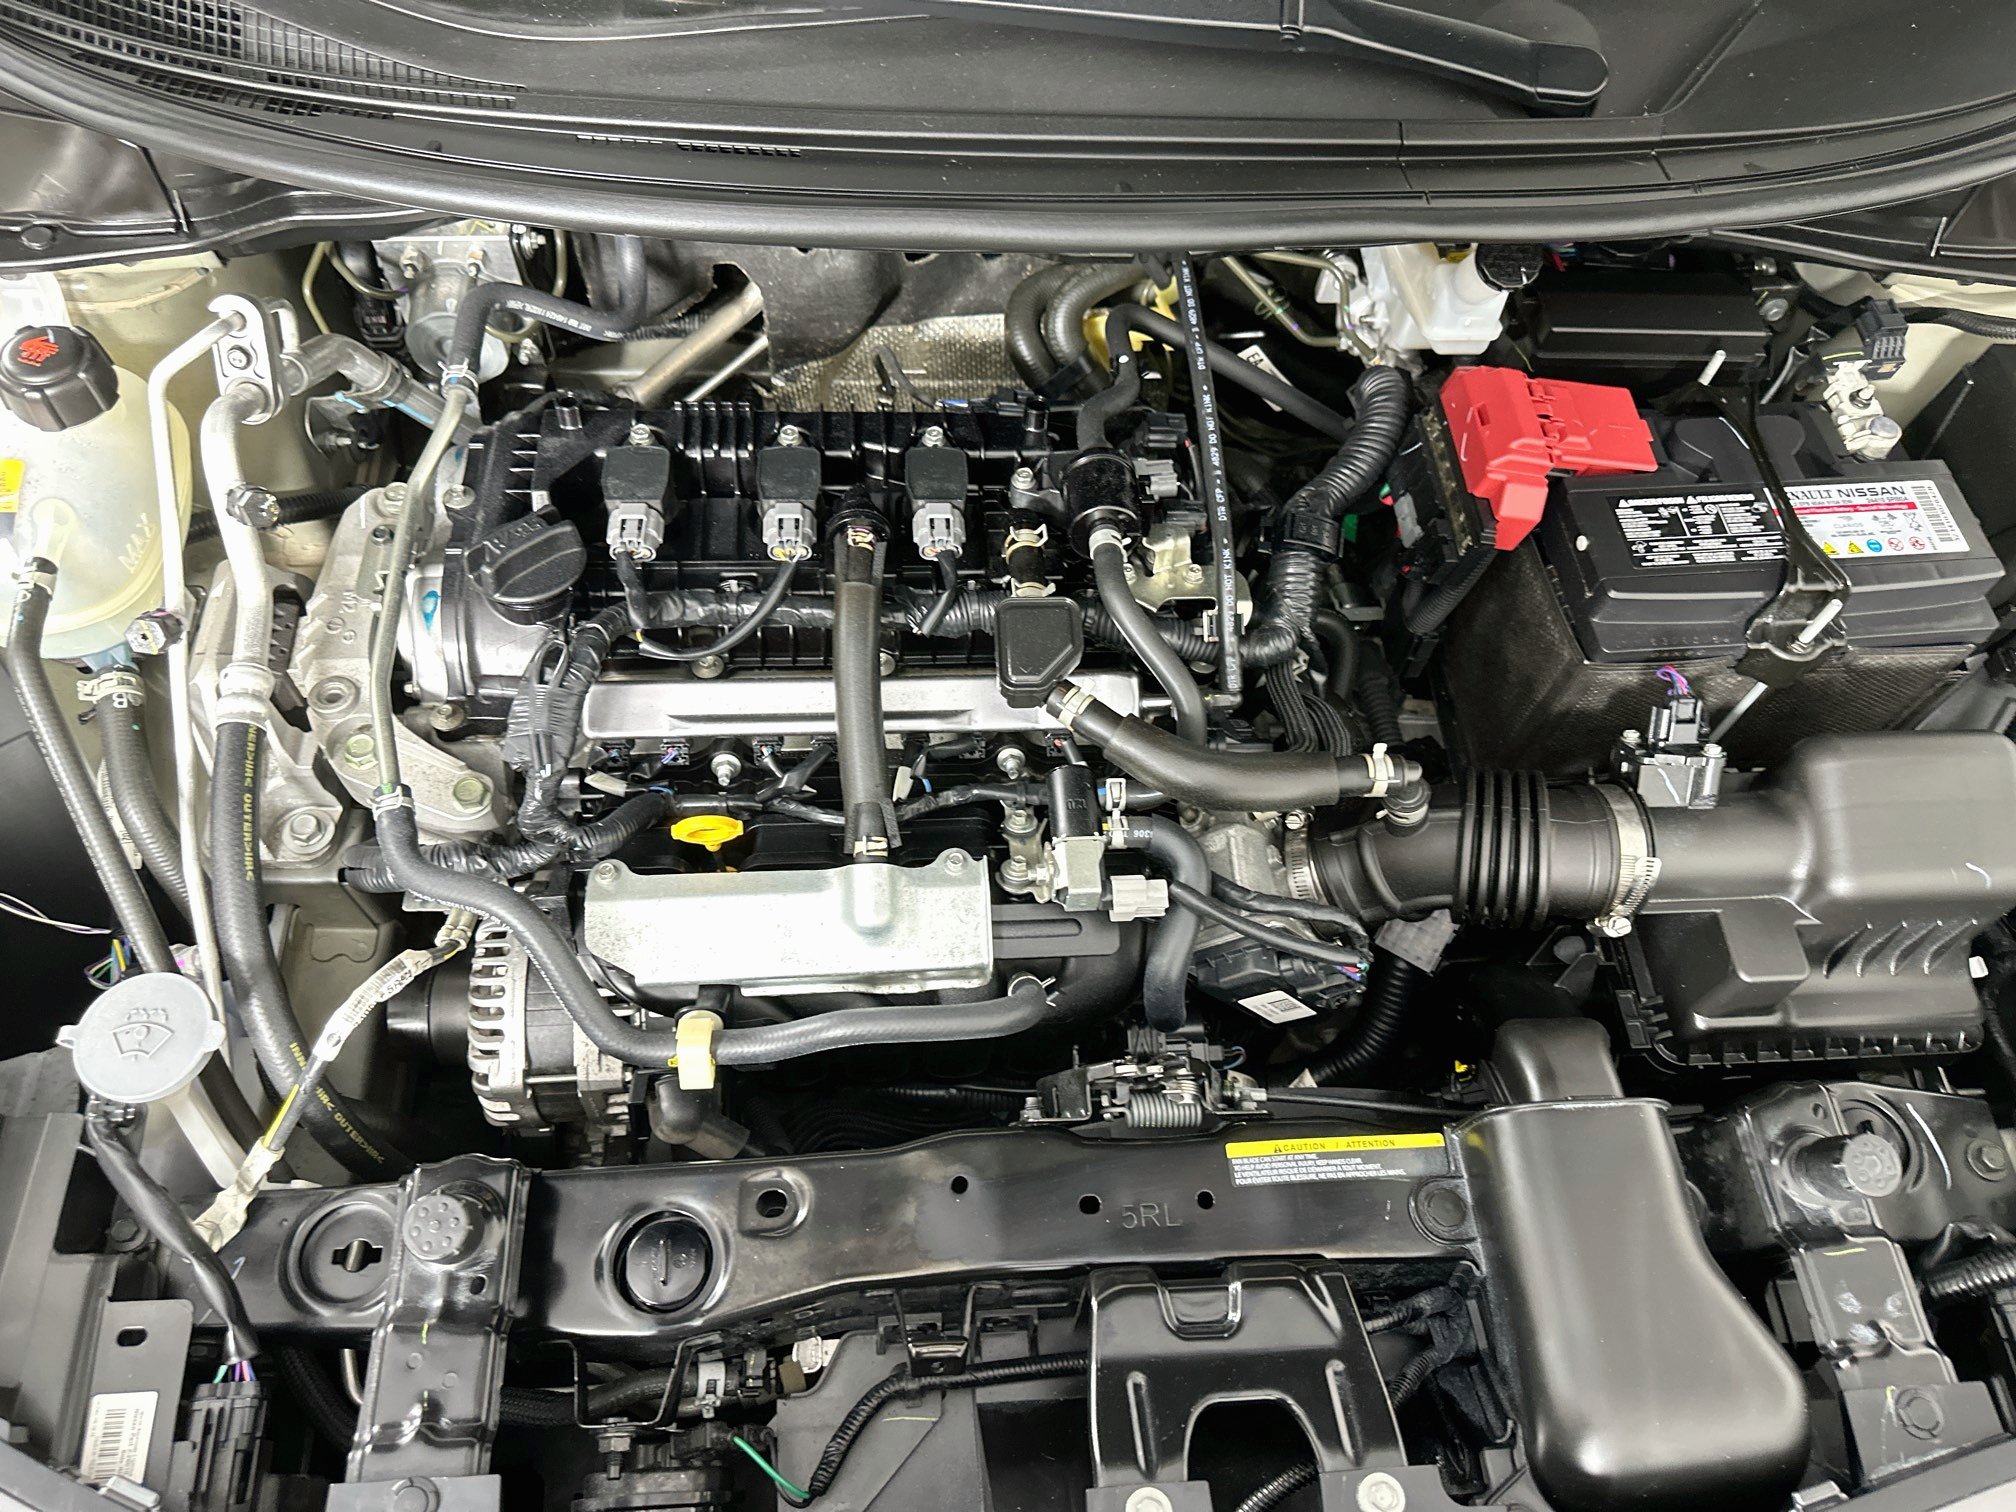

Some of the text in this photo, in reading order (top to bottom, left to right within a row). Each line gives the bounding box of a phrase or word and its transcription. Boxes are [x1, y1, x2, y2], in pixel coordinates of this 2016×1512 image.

[1182, 267, 1191, 283] KINK
[1184, 285, 1193, 297] NOT
[1187, 298, 1196, 307] DO
[1203, 394, 1213, 413] KINK
[1206, 417, 1215, 431] NOT
[1209, 434, 1217, 444] DO
[1788, 485, 1906, 501] NAULT NISSAN
[1222, 548, 1232, 569] KINK
[1224, 574, 1233, 590] NOT
[1224, 594, 1234, 606] DO
[1283, 1142, 1326, 1152] CAUTION
[1346, 1139, 1395, 1148] ATTENTION
[1122, 1203, 1183, 1229] 5RL
